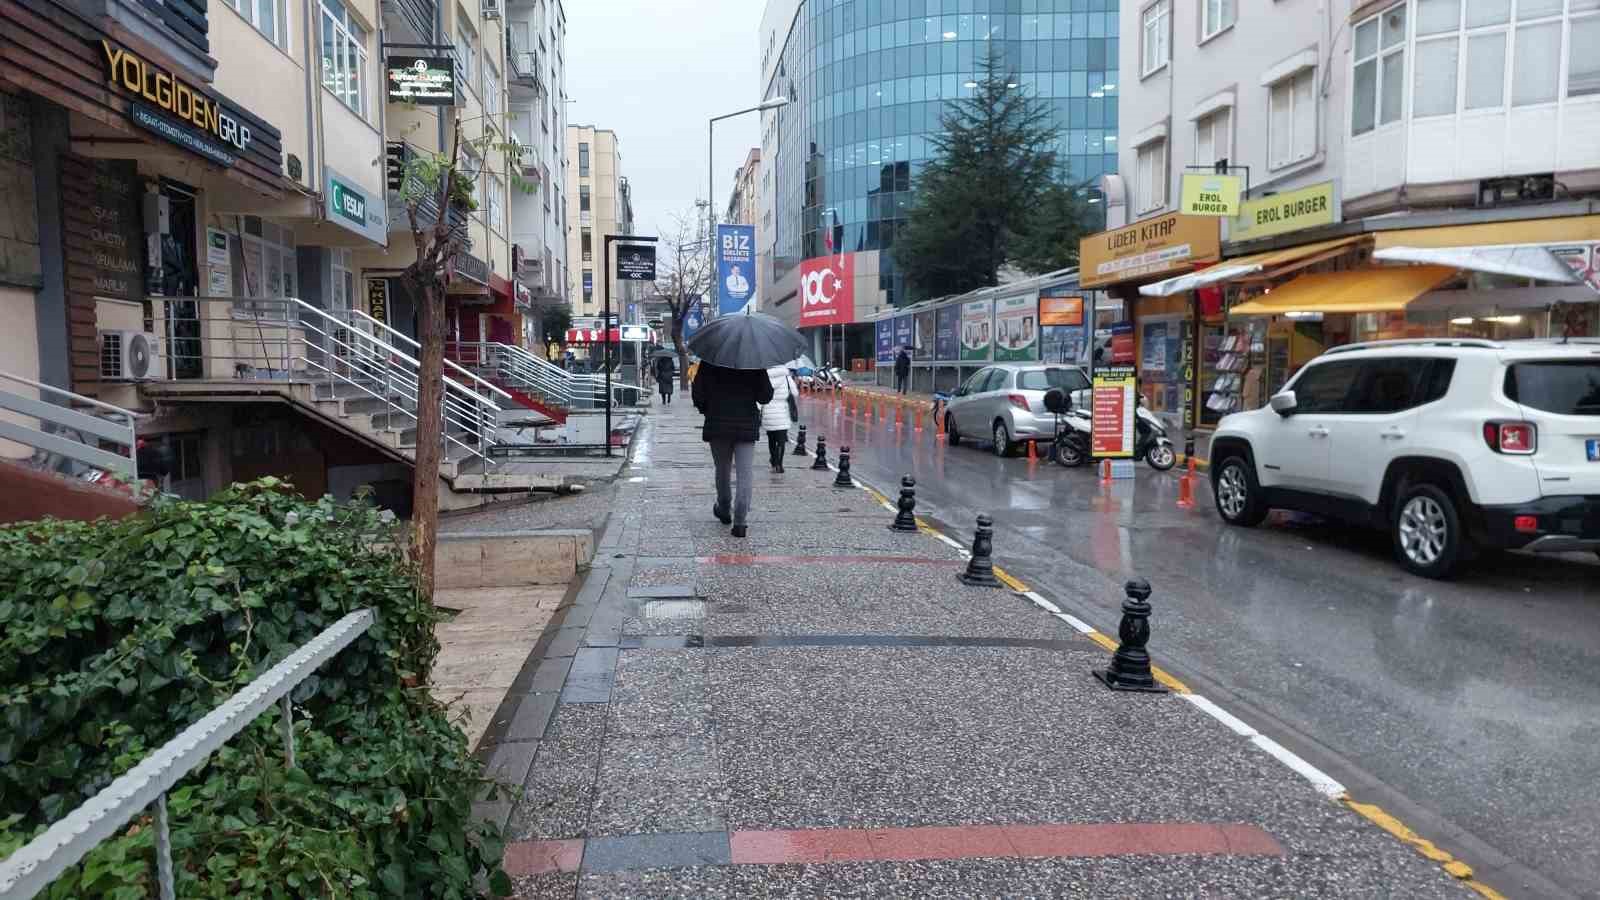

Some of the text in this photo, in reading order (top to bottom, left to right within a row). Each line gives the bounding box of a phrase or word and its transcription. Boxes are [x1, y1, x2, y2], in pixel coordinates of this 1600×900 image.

[218, 113, 251, 151] GRUP
[1192, 203, 1227, 213] BURGER
[1200, 193, 1221, 202] EROL
[1256, 195, 1327, 225] EROL BURGER
[723, 230, 750, 250] BİZ
[1108, 230, 1137, 250] LİDER
[1141, 218, 1176, 241] KİTAP
